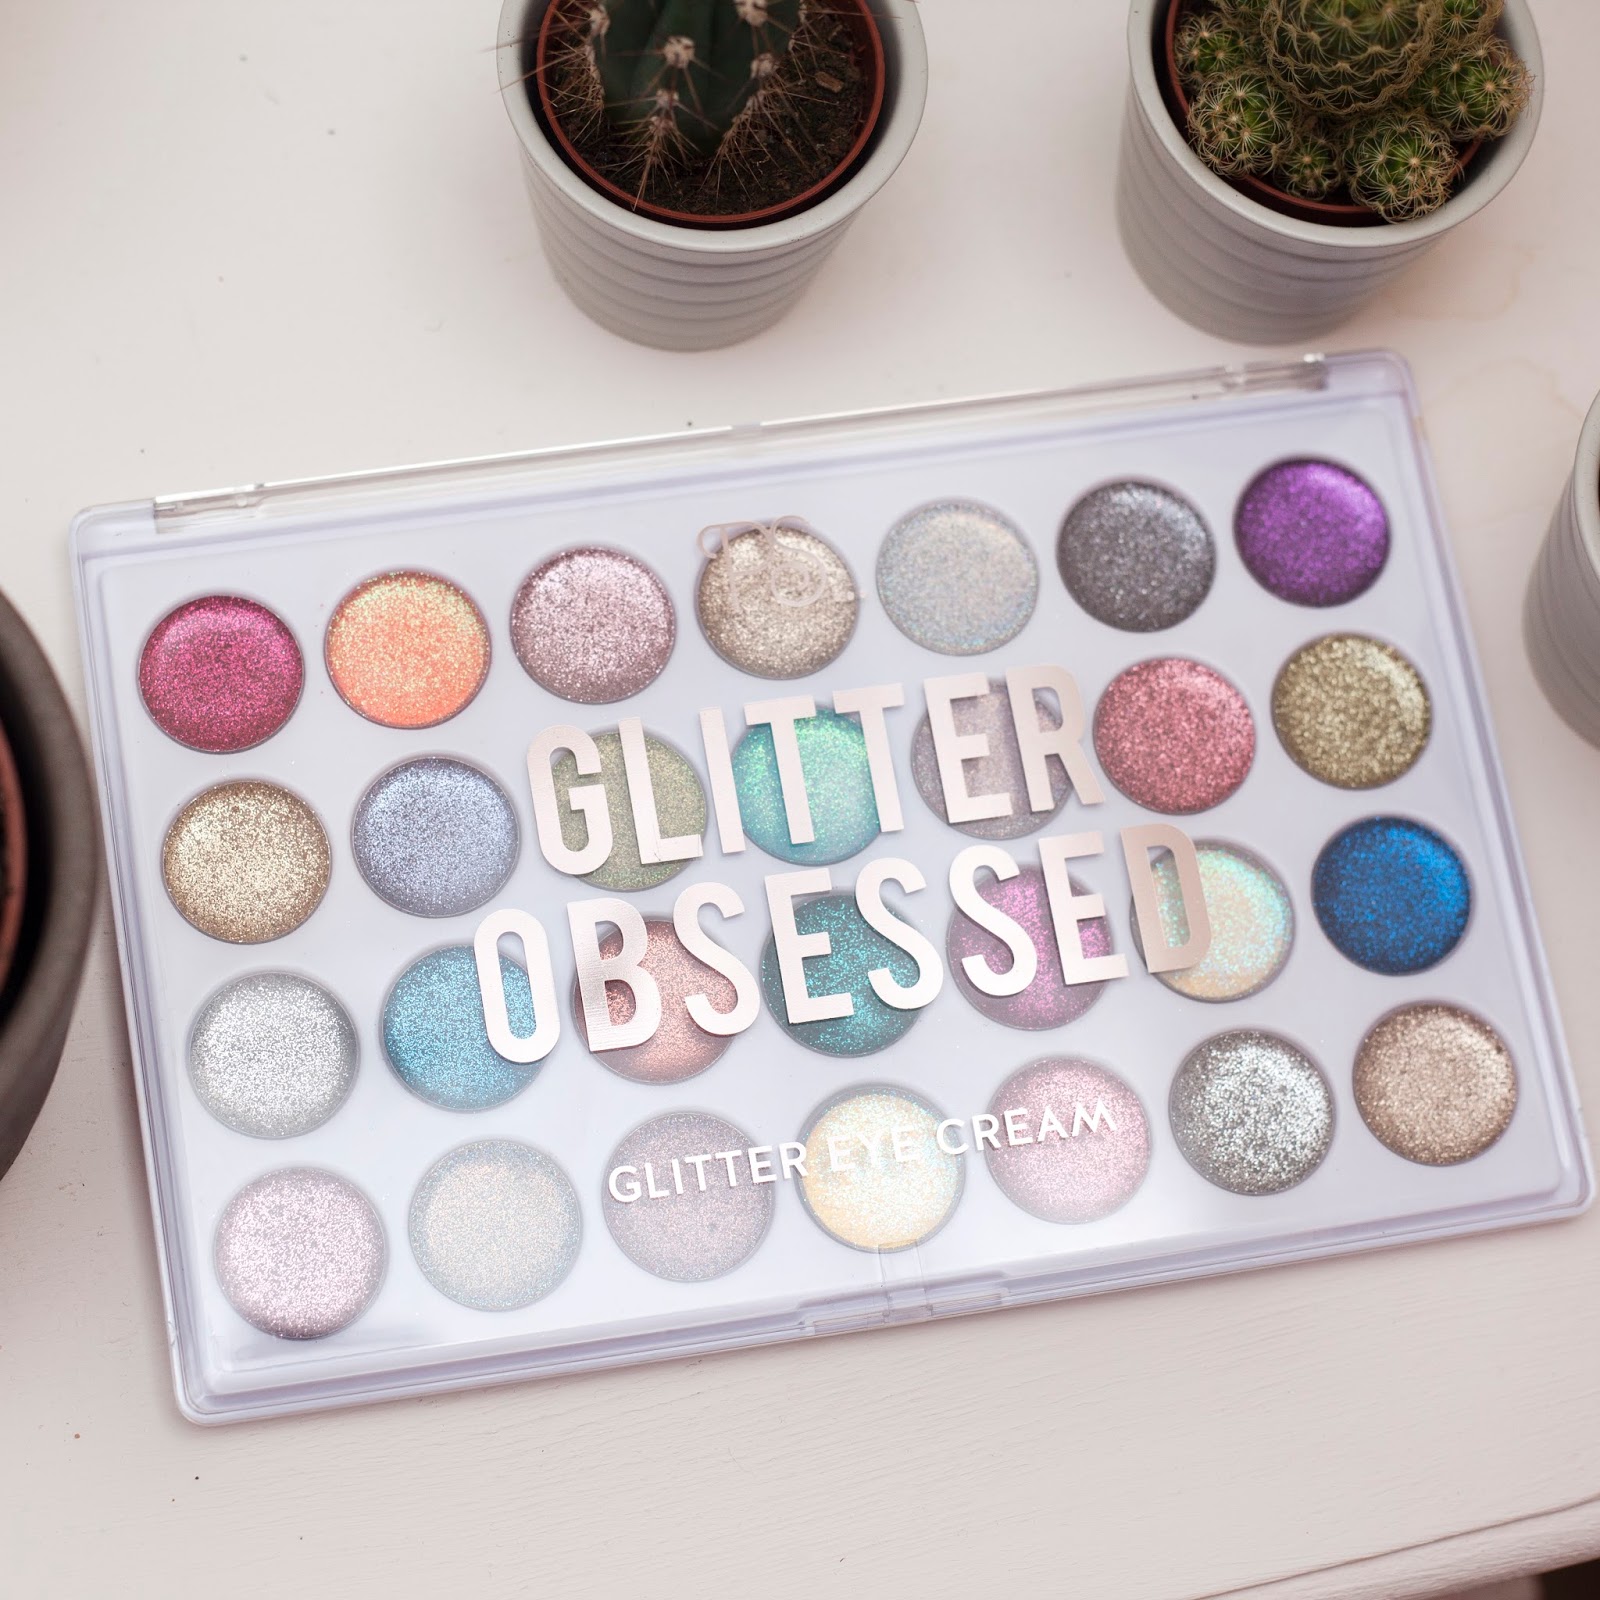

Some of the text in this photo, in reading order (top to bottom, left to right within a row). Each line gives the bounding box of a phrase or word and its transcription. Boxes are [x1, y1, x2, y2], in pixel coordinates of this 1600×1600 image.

[526, 664, 1105, 876] GLITTER
[473, 823, 1213, 1064] OBSESSED
[608, 1099, 1119, 1204] GLITTER EYE CREAM
